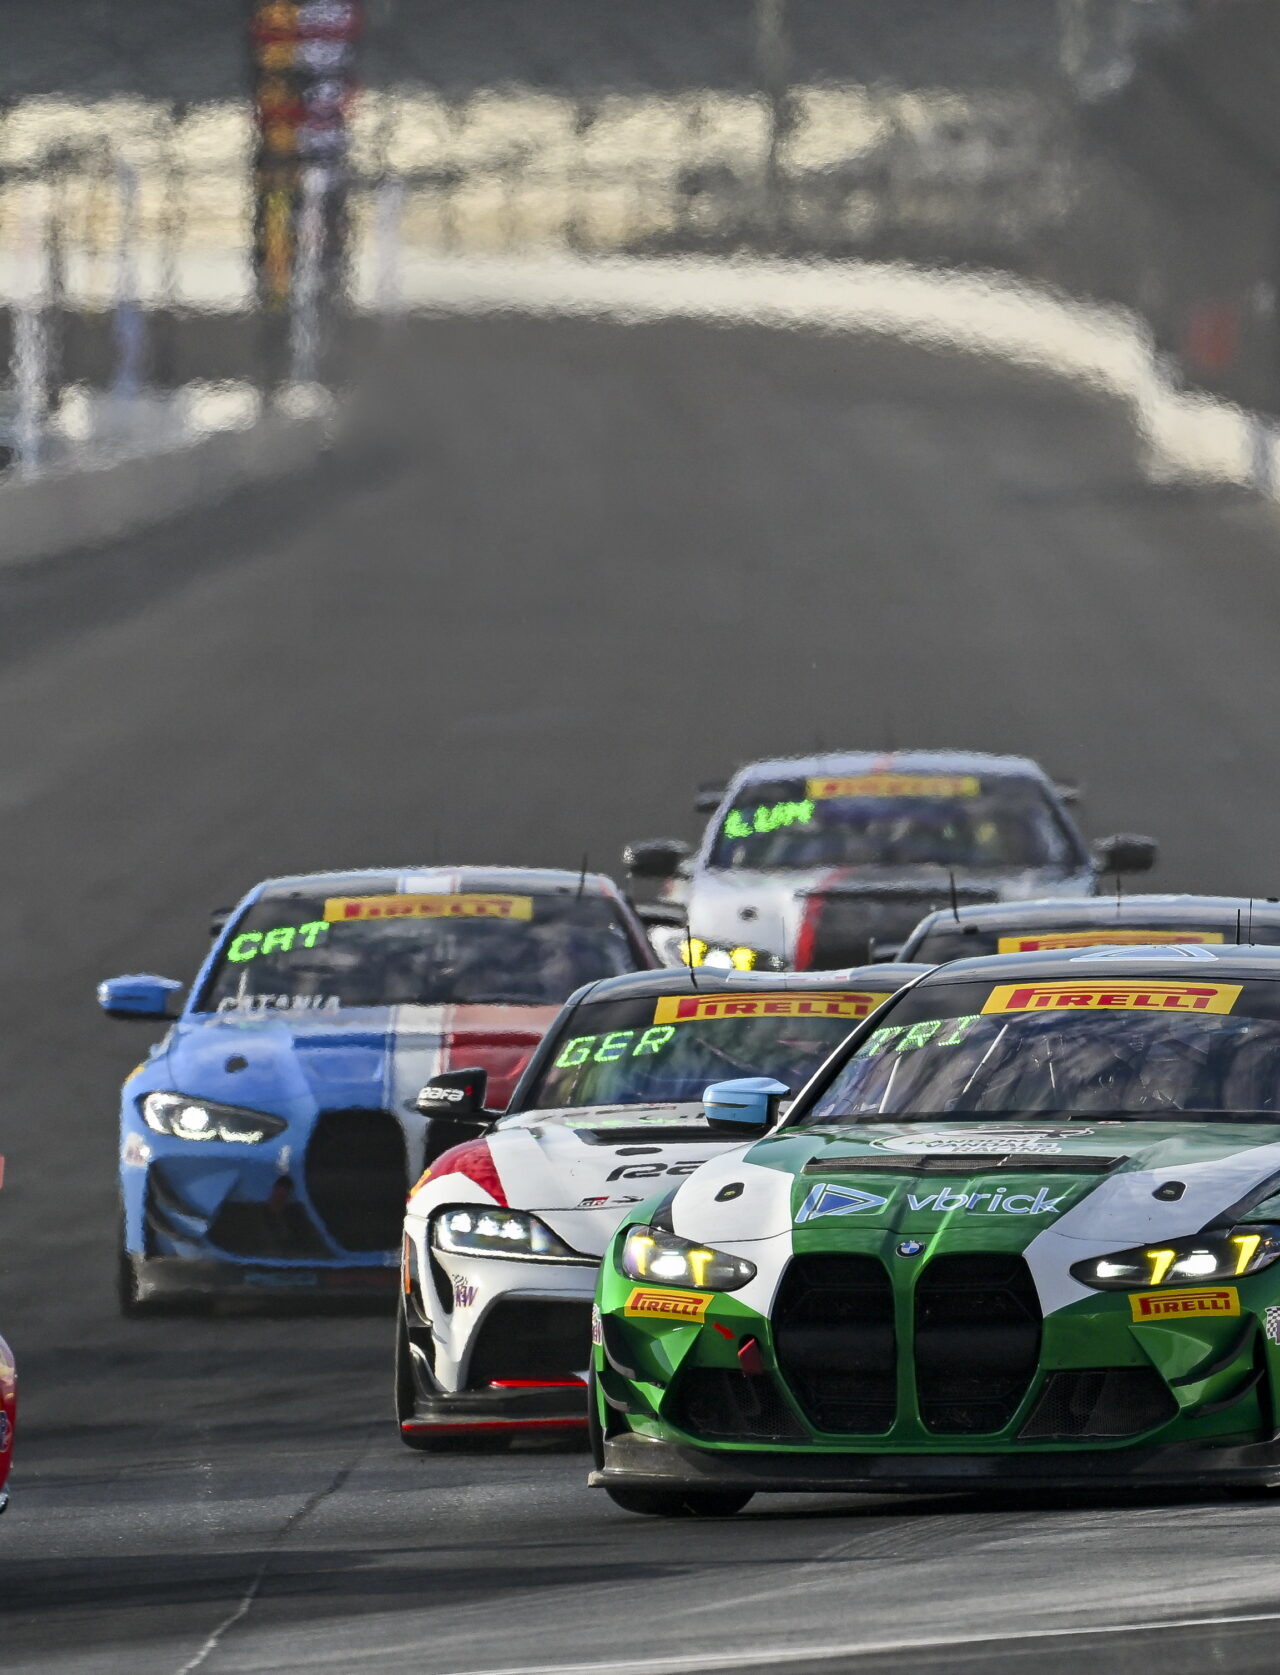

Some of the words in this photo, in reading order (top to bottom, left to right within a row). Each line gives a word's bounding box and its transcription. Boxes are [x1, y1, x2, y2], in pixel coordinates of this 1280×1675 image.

[227, 920, 330, 963] CAT
[676, 992, 874, 1018] PIRELLI
[1005, 985, 1218, 1009] PIRELLI
[556, 1026, 676, 1068] GER
[868, 1014, 980, 1056] TRI
[906, 1187, 1063, 1214] vbrick
[630, 1292, 704, 1316] PIRELLI
[1138, 1291, 1230, 1315] PIRELLI
